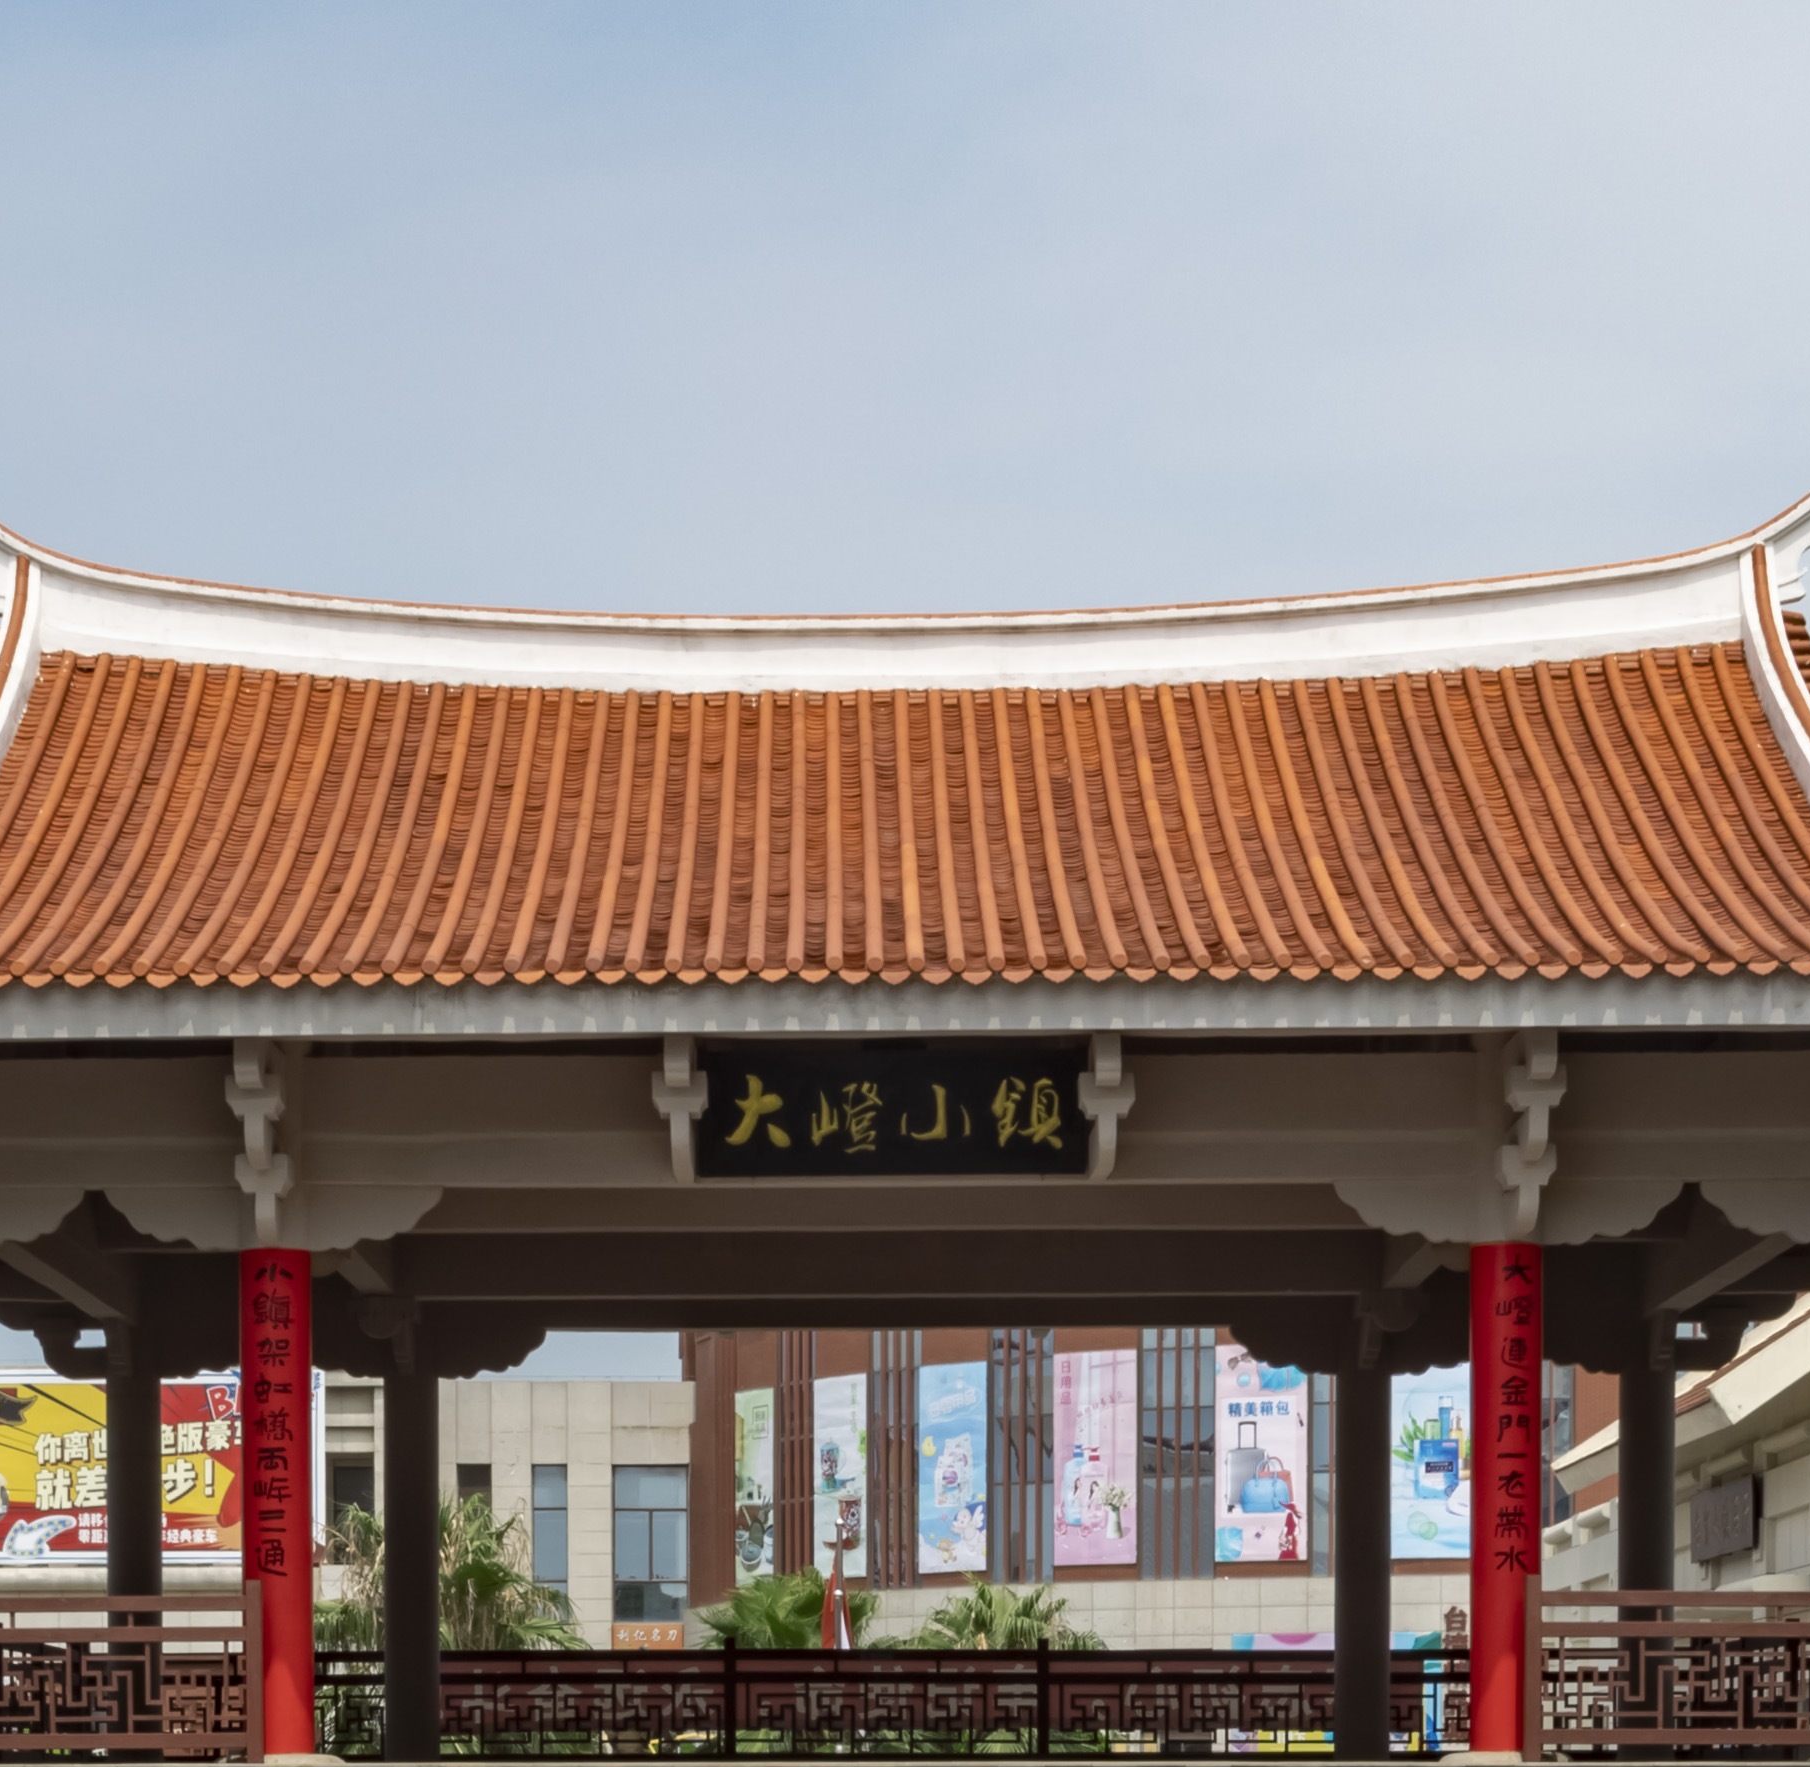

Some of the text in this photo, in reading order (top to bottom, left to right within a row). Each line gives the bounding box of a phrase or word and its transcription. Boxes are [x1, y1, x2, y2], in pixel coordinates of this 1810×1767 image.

[725, 1074, 1064, 1154] 大嶝小鎮
[1059, 1360, 1072, 1406] 日用品
[1227, 1400, 1291, 1418] 精美箱包
[35, 1458, 215, 1511] 就差步！
